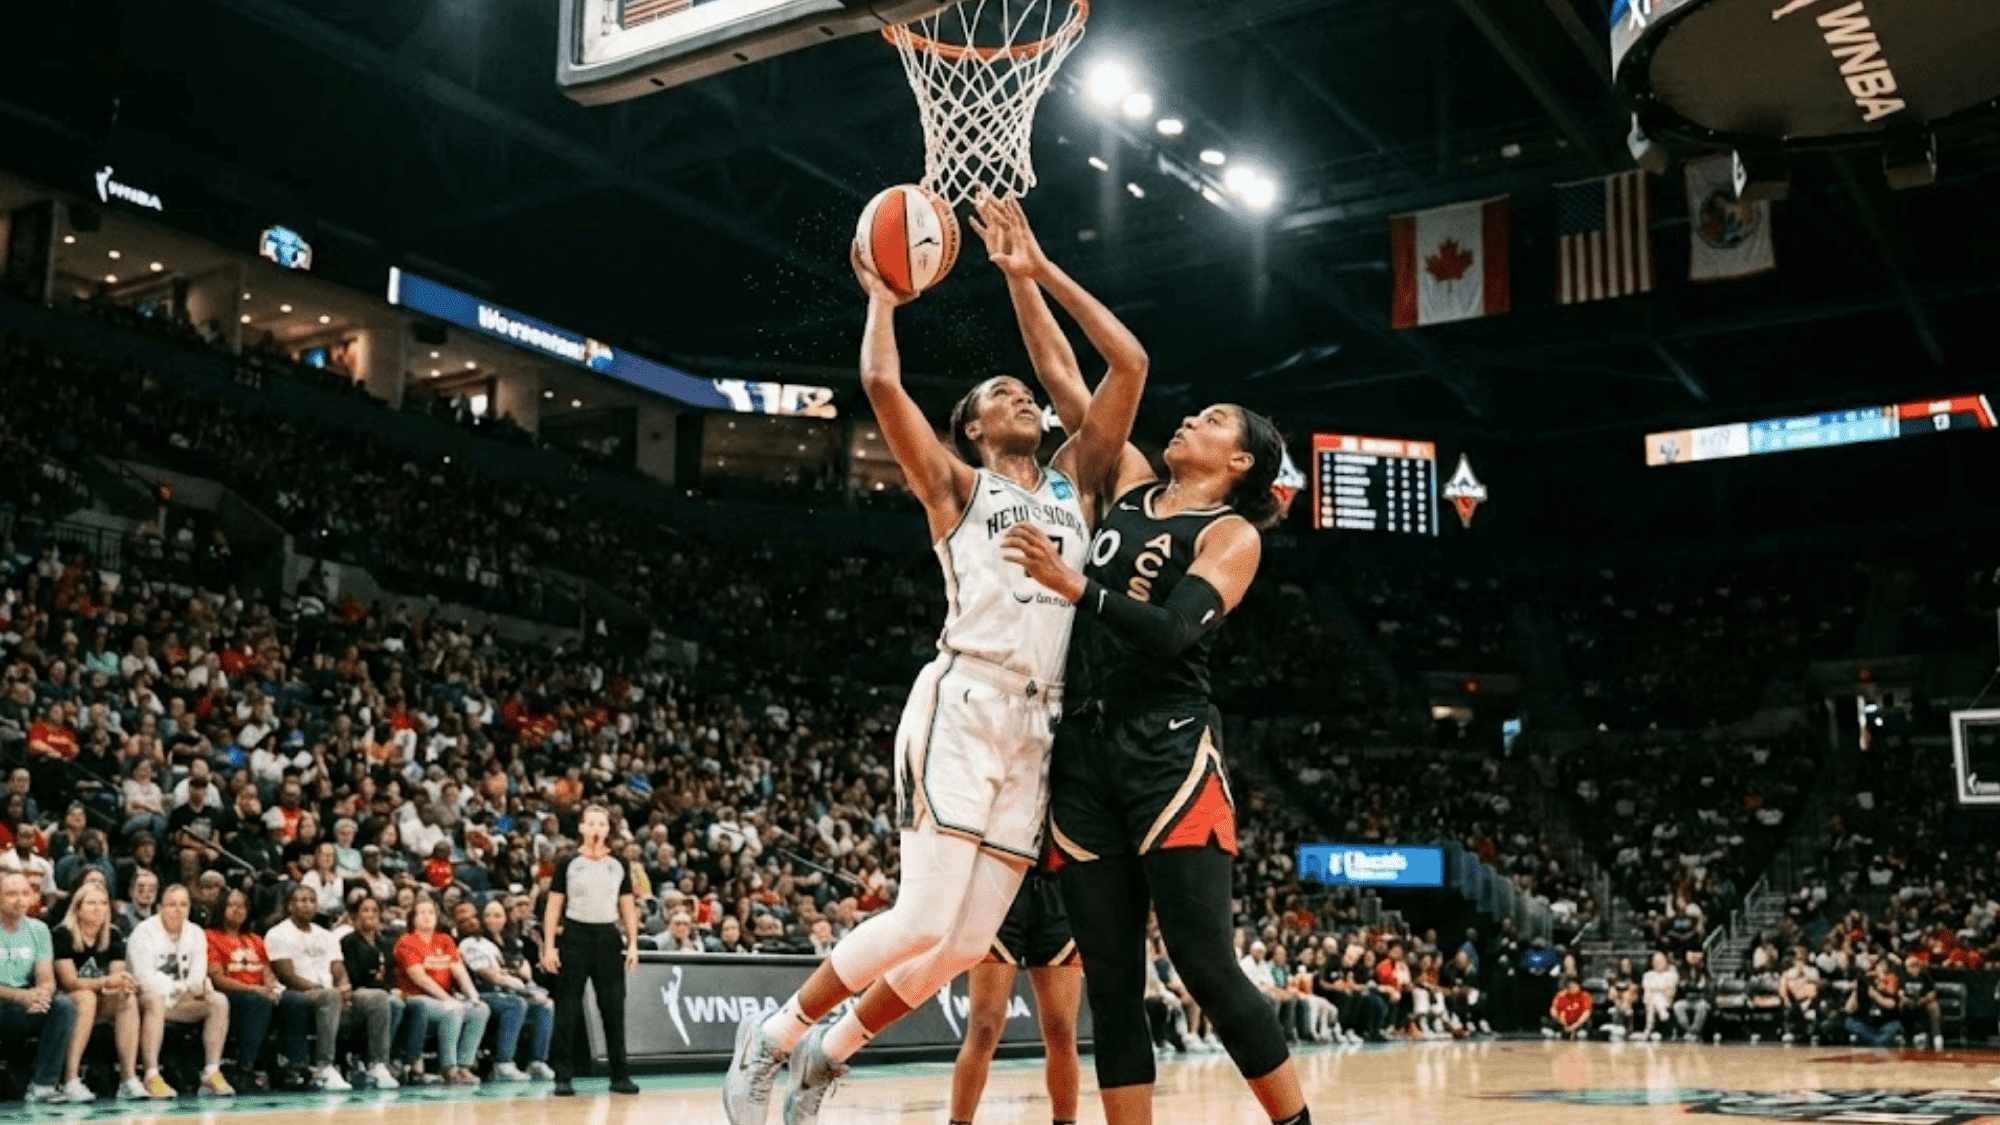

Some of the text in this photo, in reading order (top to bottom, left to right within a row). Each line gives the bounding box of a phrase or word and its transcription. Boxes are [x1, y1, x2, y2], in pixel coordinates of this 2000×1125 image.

[1816, 1, 1906, 122] WNBA
[683, 996, 780, 1023] WNBA
[952, 995, 1032, 1019] WA
